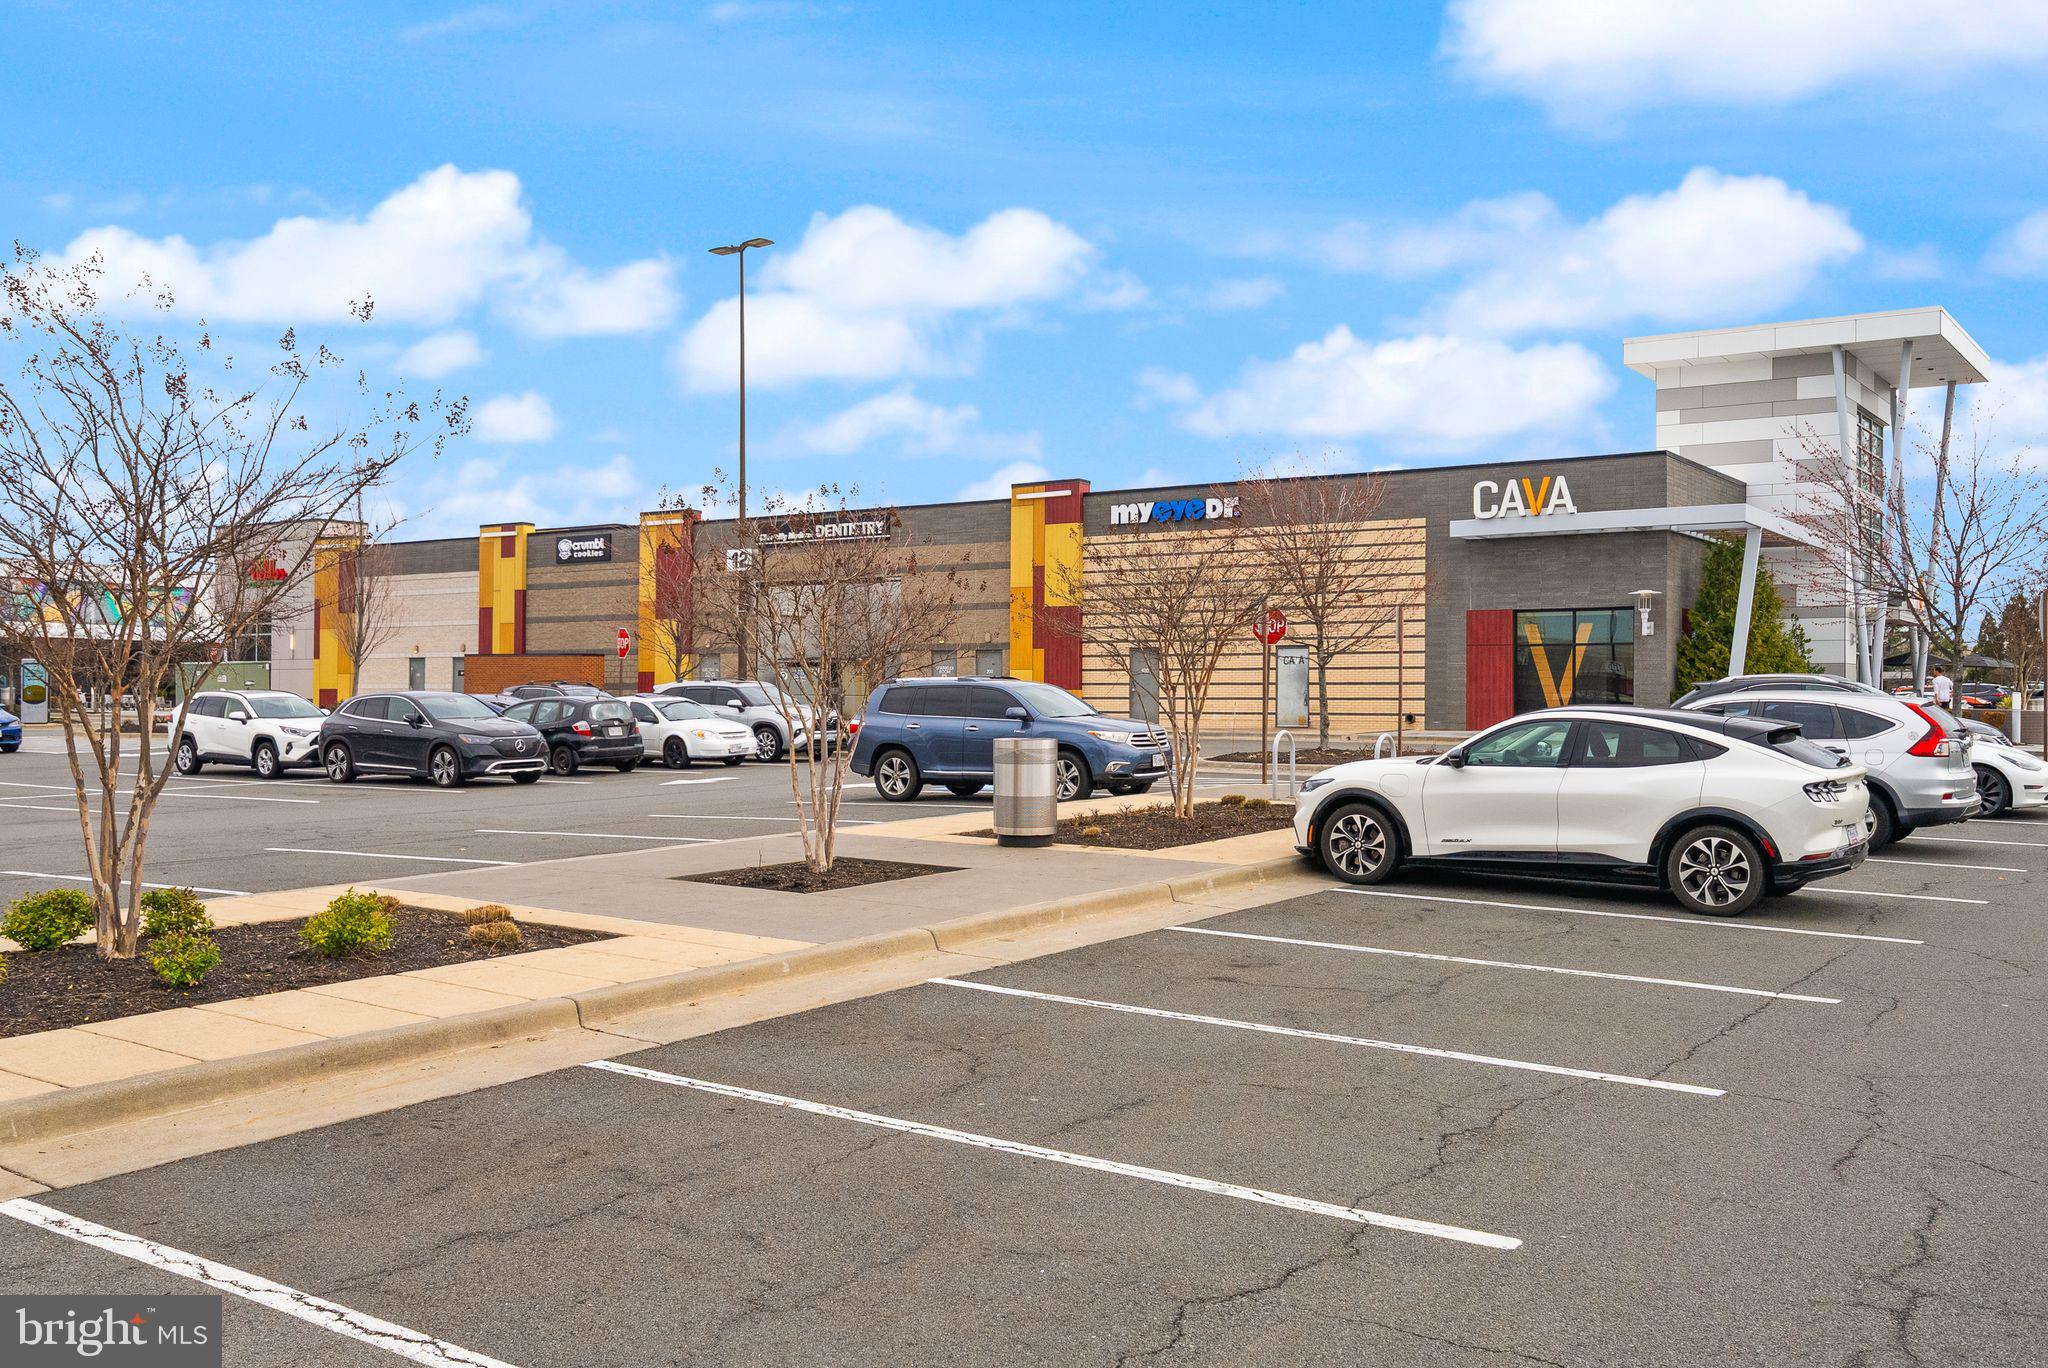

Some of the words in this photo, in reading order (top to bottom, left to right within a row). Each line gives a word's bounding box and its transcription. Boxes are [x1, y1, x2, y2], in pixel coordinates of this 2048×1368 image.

[1473, 475, 1575, 519] CAVA
[815, 520, 884, 538] DENTISTRY
[572, 537, 605, 550] crumbl
[573, 550, 604, 558] cookies
[732, 551, 750, 568] 12
[1283, 655, 1305, 665] CAA
